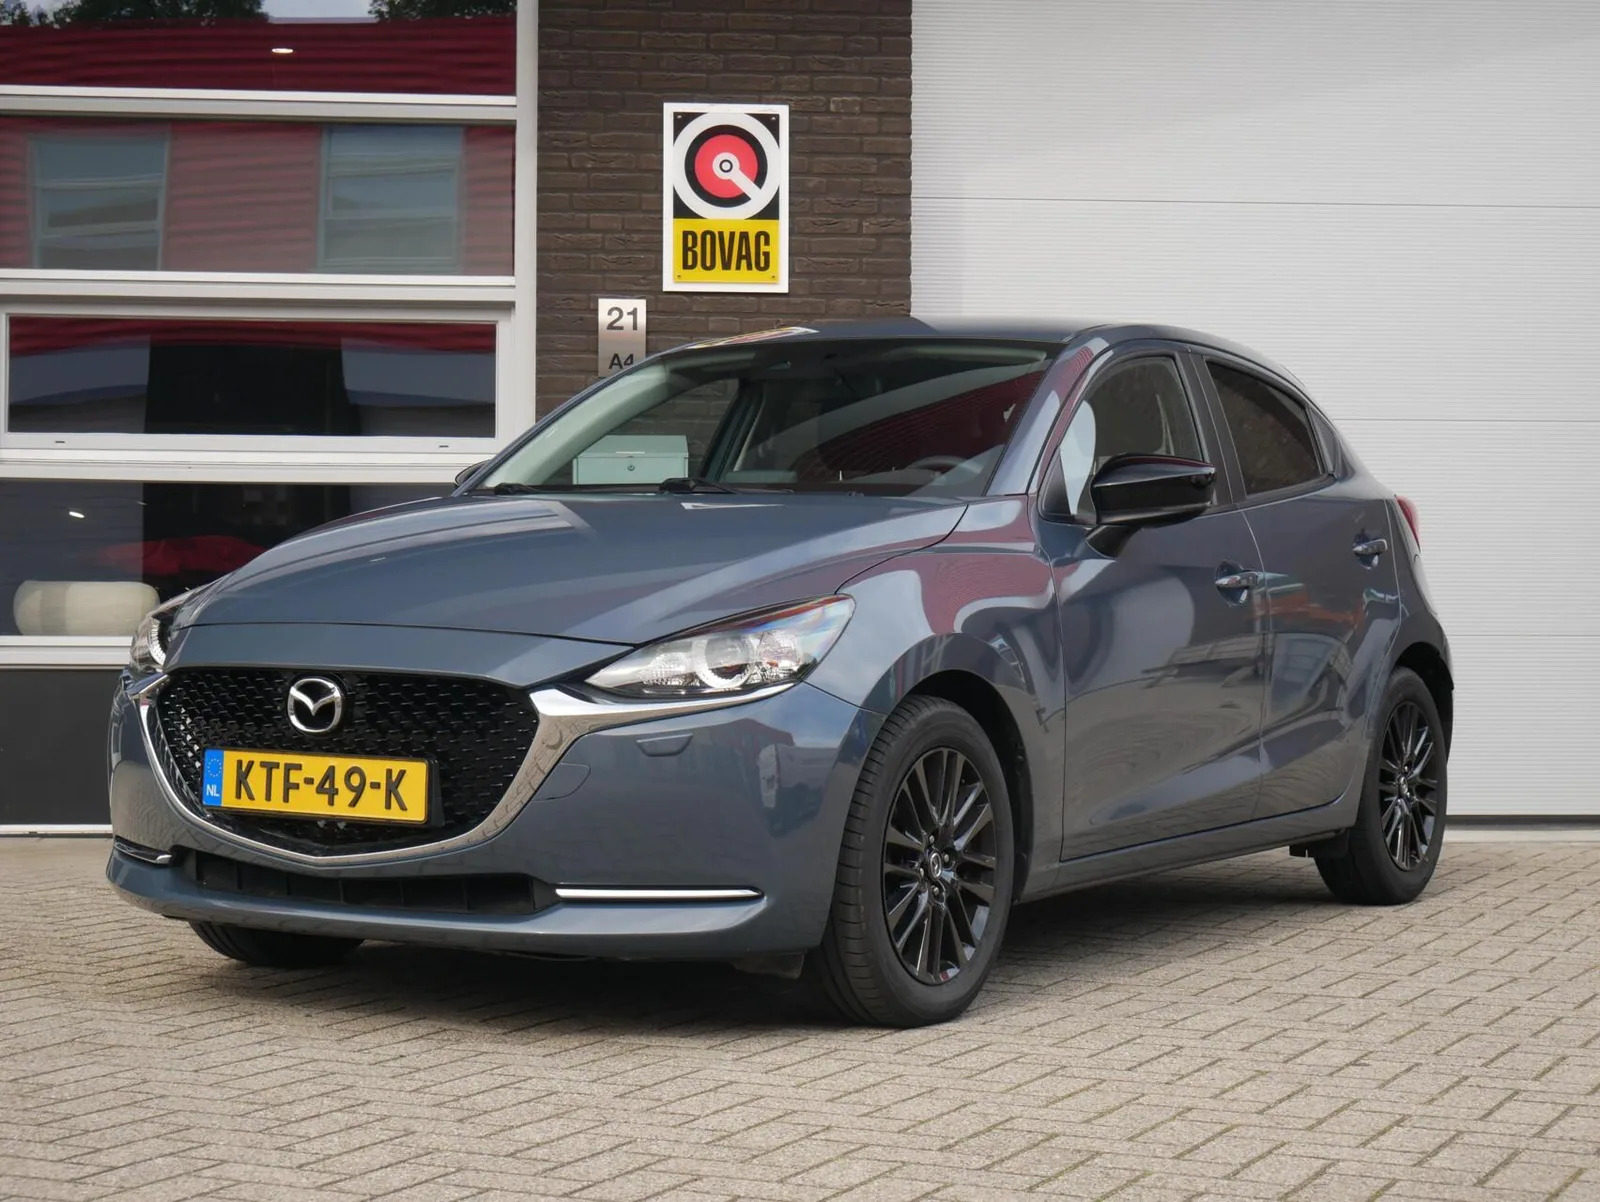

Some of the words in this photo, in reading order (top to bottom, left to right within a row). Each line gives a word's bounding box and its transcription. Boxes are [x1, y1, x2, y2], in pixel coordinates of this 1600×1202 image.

[682, 230, 770, 272] BOVAG
[606, 306, 638, 331] 21
[206, 785, 220, 797] NL
[235, 759, 408, 811] KTF-49-K
